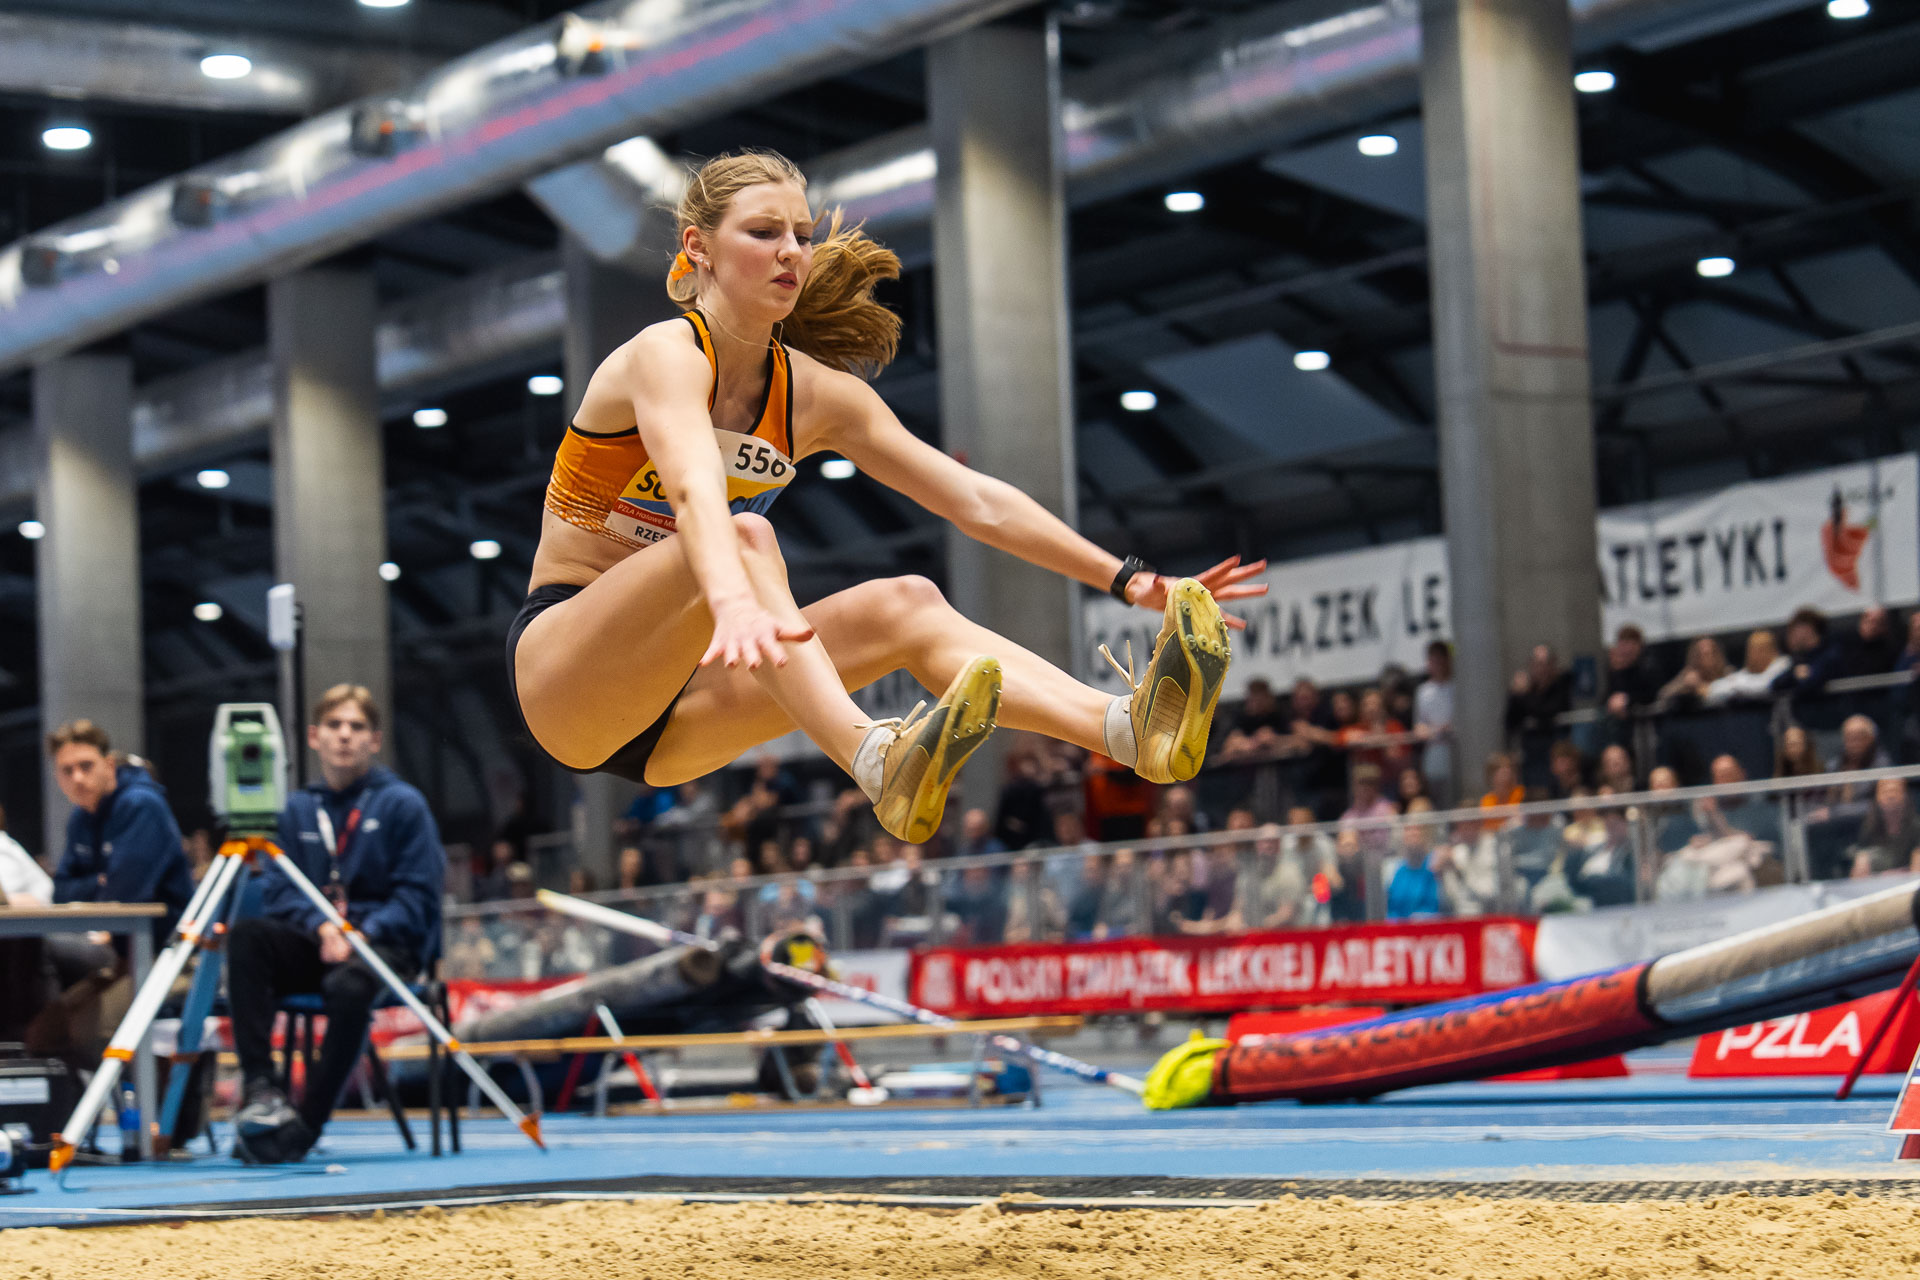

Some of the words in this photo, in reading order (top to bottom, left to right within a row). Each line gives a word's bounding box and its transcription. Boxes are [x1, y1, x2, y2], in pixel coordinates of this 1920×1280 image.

[734, 442, 787, 477] 556
[617, 503, 635, 515] PZLA
[636, 510, 663, 525] Halowe
[1715, 1011, 1863, 1060] PZLA
